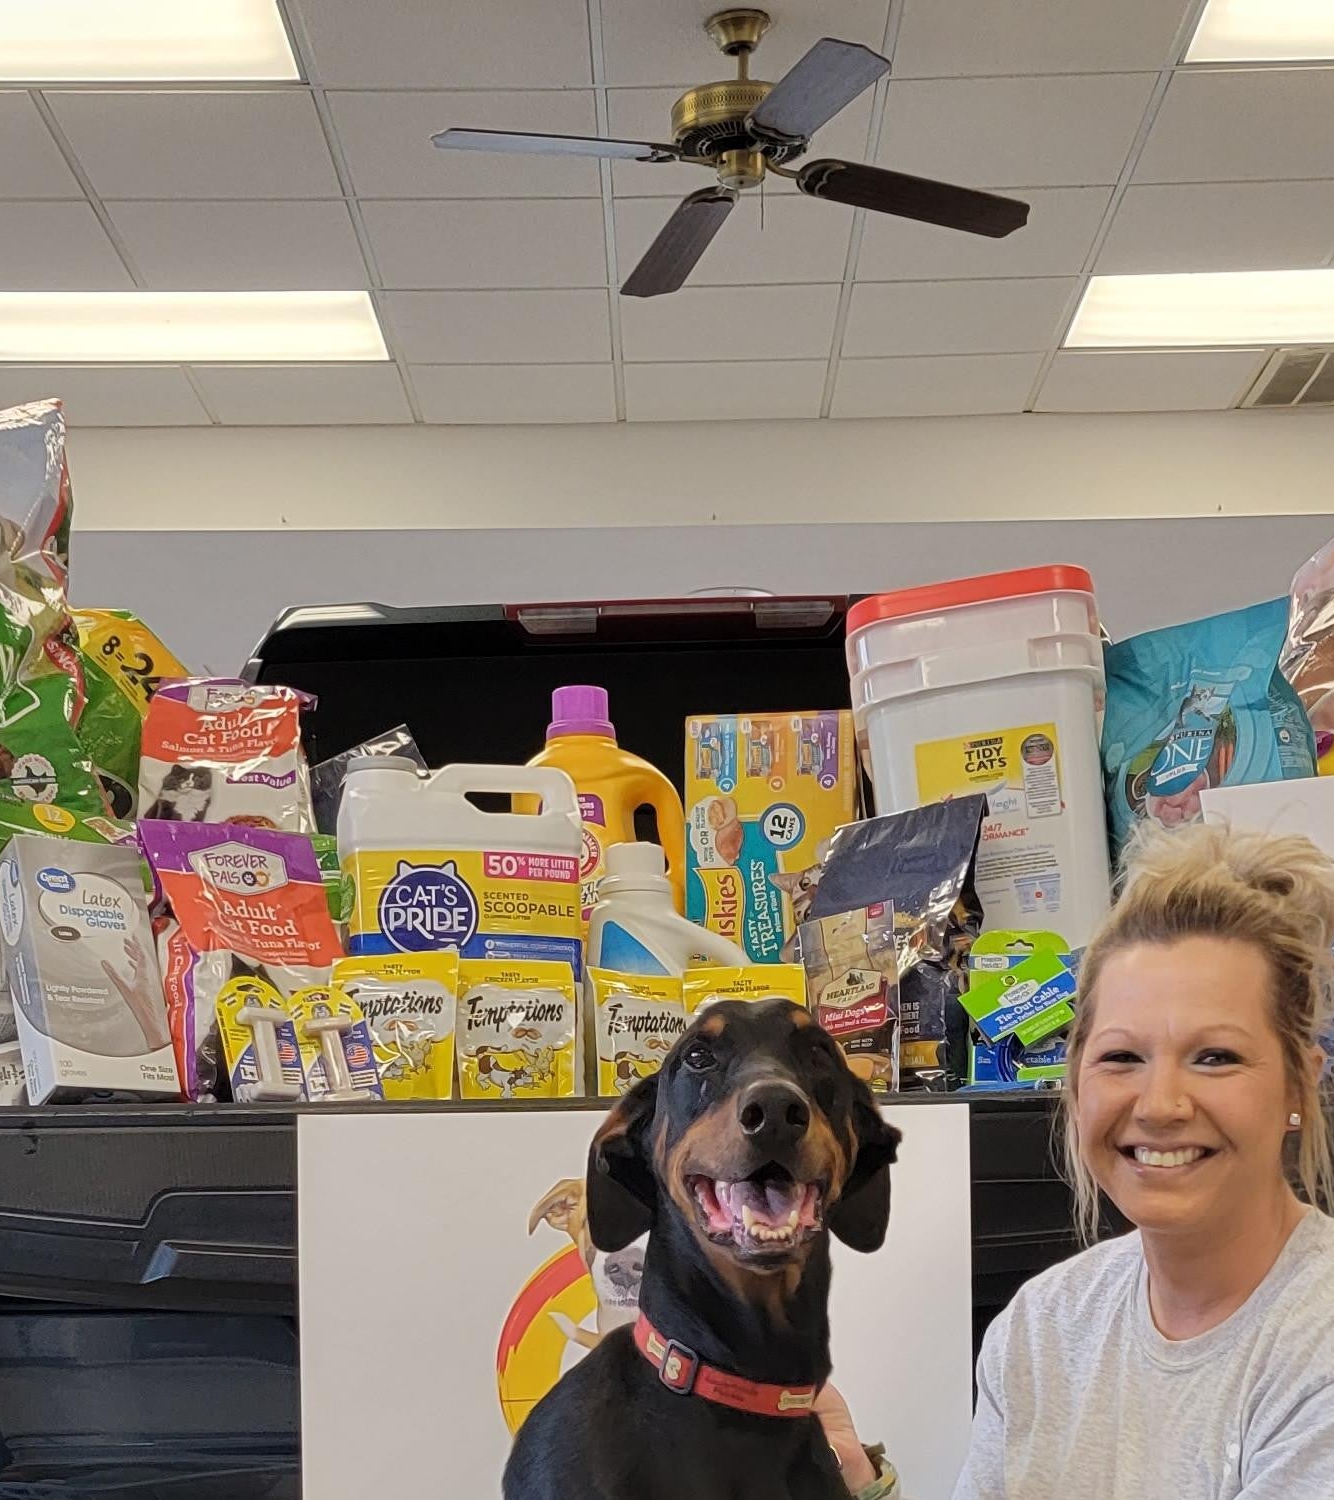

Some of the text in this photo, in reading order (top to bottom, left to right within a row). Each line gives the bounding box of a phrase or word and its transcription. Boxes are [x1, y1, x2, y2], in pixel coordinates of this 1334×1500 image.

[183, 722, 263, 745] Cat Food
[964, 746, 1004, 762] TIDY
[965, 757, 1007, 773] CATS
[770, 814, 788, 839] 12
[785, 816, 797, 841] CANS
[699, 830, 709, 846] OR
[203, 853, 269, 869] FOREVER
[528, 857, 549, 868] MORE
[550, 858, 575, 870] LITTER
[211, 870, 241, 884] PALS
[528, 868, 571, 880] PER POUND
[82, 889, 122, 908] Latex
[395, 884, 458, 907] CAT'S
[483, 891, 530, 901] SCENTED
[59, 904, 125, 921] Disposable
[223, 899, 278, 921] Adult
[483, 901, 576, 918] SCOOPABLE
[712, 874, 738, 937] iskies
[750, 859, 779, 957] TREASURES
[85, 917, 127, 931] Gloves
[247, 919, 300, 937] Food
[388, 906, 469, 941] PRIDE
[748, 919, 759, 951] TASTY
[251, 938, 285, 950] Tuna
[826, 983, 875, 1000] HEARTLAND
[994, 1002, 1034, 1025] Tie-Out
[1032, 986, 1060, 1004] Cable
[825, 1008, 865, 1023] Mini Dogs
[140, 1064, 157, 1072] One
[142, 1072, 156, 1081] Fits
